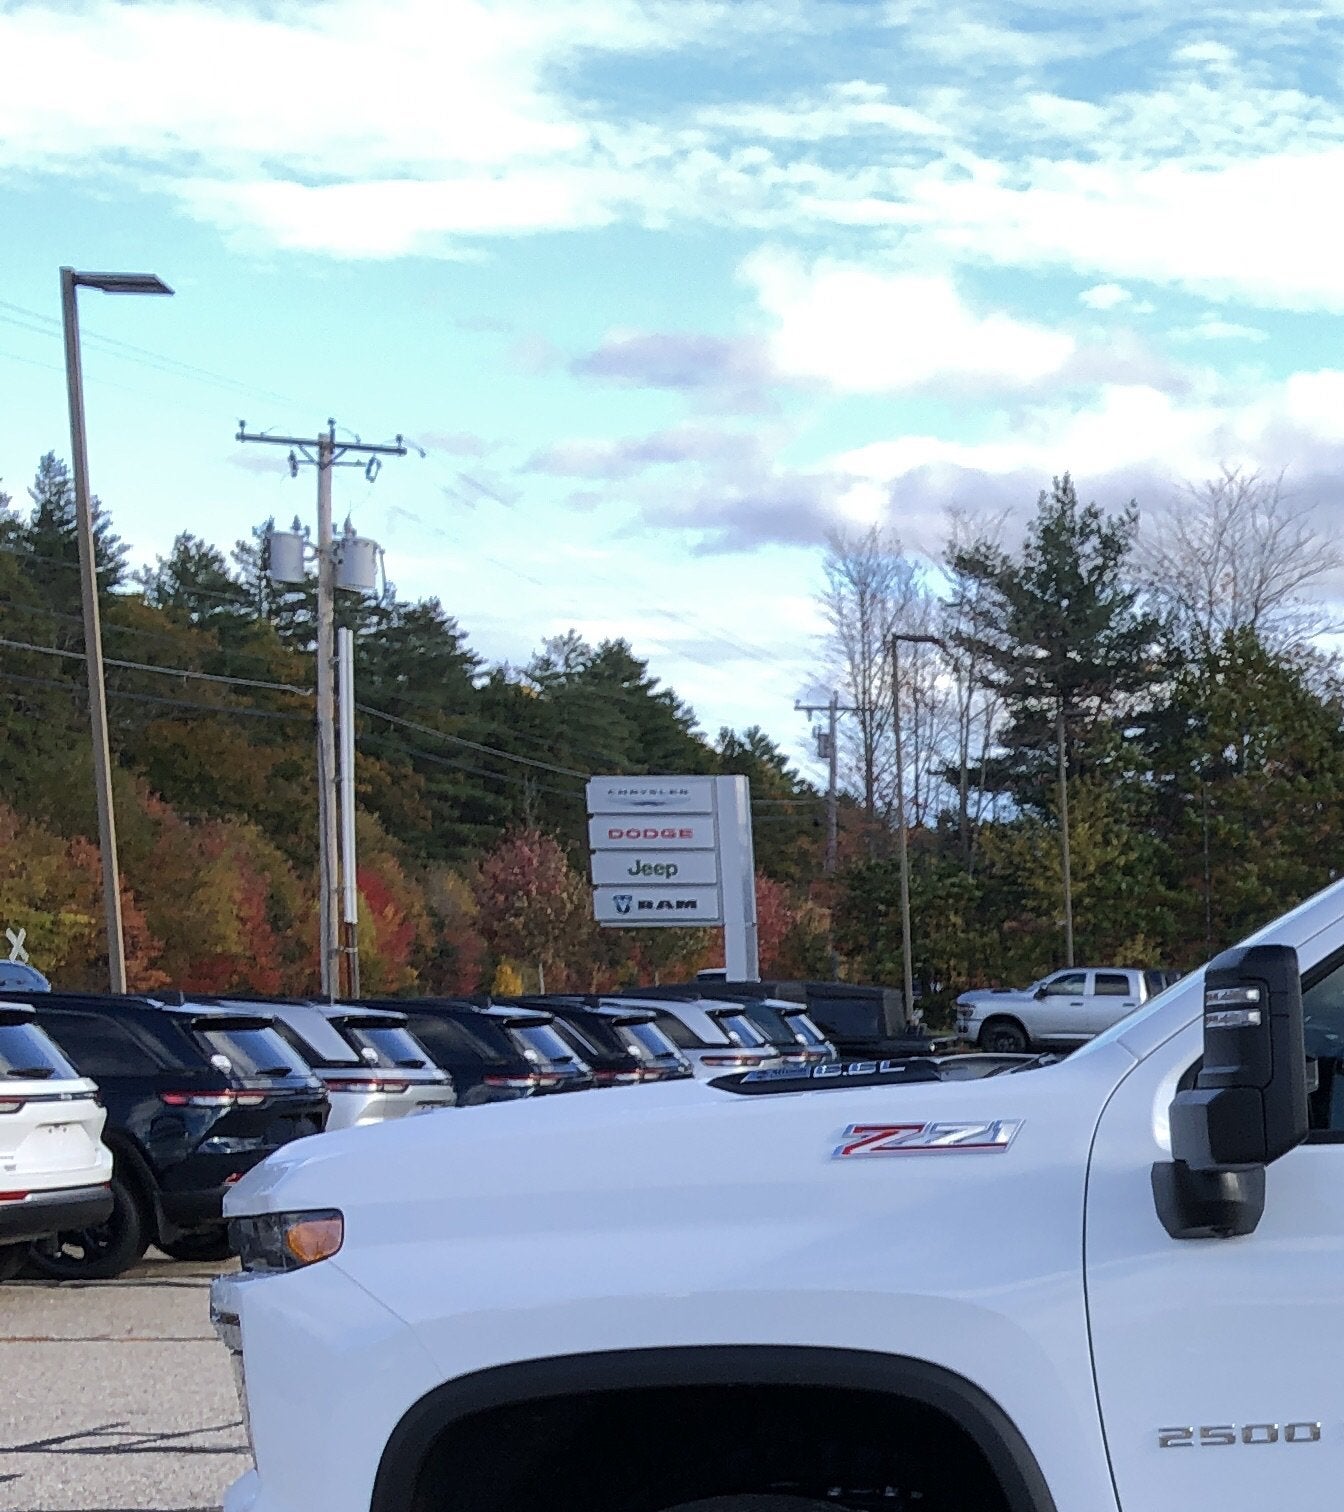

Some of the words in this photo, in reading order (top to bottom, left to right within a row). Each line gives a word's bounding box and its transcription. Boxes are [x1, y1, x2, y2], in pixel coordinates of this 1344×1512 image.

[608, 828, 694, 839] DODGE
[628, 859, 678, 879] Jeep
[637, 900, 697, 910] RAM
[831, 1118, 1027, 1160] Z71
[1158, 1421, 1322, 1448] 2500
